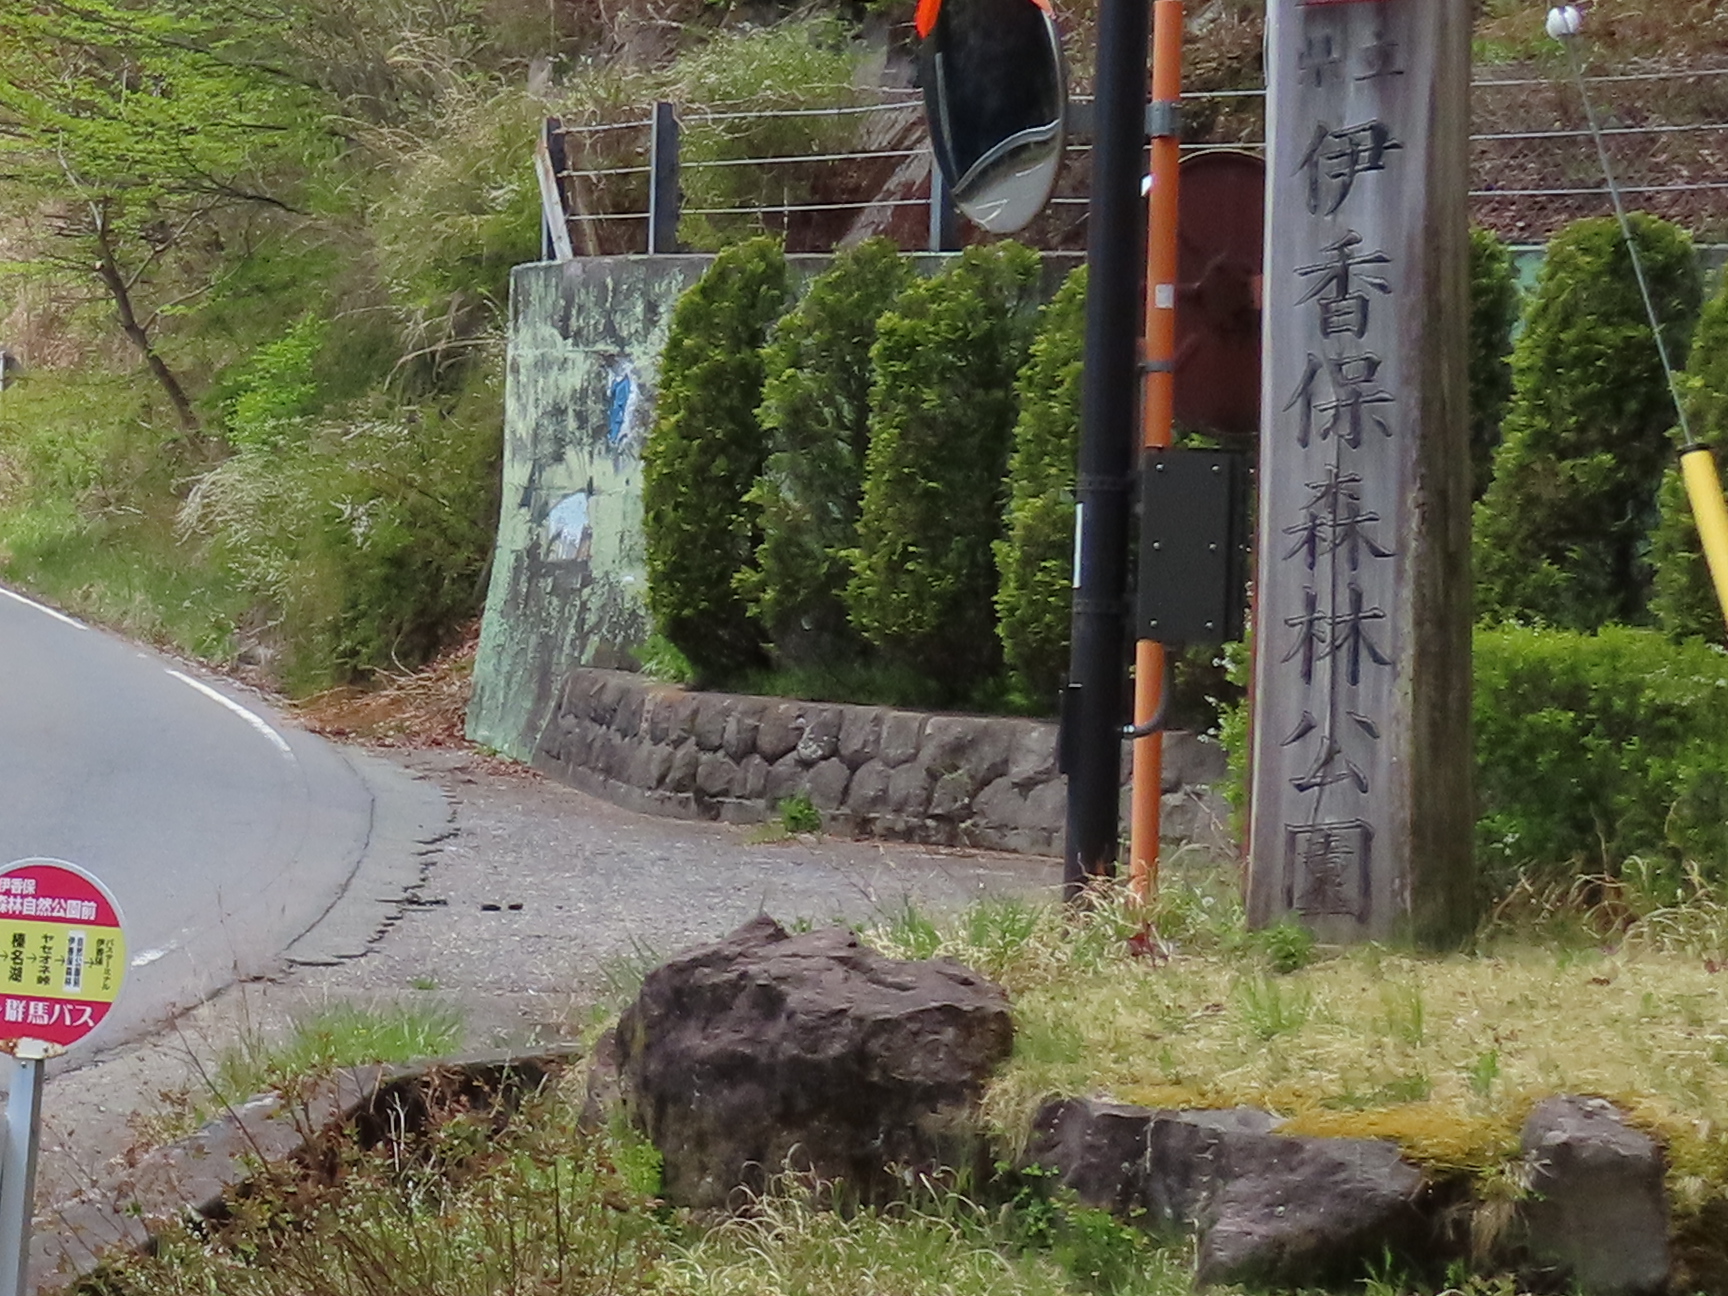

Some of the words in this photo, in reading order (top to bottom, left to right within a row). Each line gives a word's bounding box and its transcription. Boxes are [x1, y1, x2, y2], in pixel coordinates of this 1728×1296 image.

[1281, 117, 1404, 924] 伊香保森林公園
[8, 932, 27, 983] 榛名湖
[36, 933, 55, 985] ヤセオネ峠
[101, 938, 115, 991] バスターミナル
[4, 998, 95, 1027] 群馬バス
